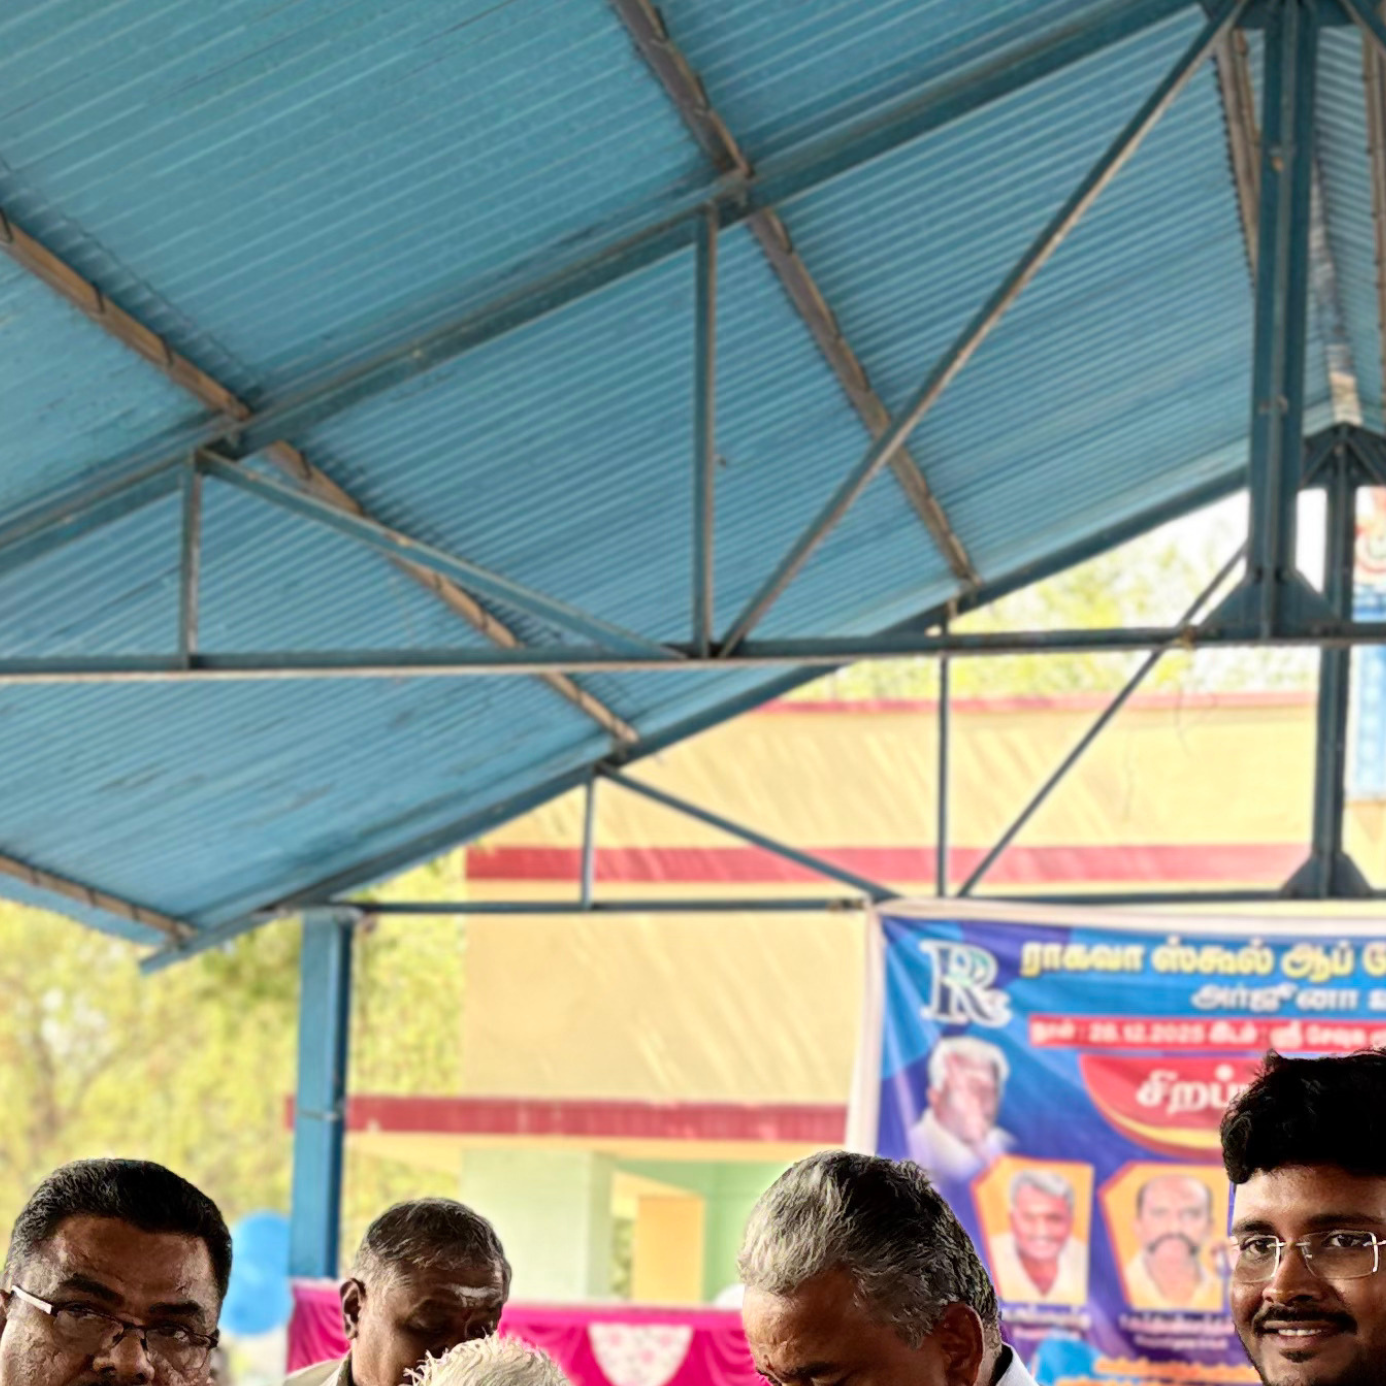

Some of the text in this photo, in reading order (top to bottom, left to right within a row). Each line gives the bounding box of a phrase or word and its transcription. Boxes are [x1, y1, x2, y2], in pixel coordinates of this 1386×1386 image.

[1020, 941, 1145, 977] ராகவா
[1151, 935, 1274, 977] ஸ்கூல்
[1281, 939, 1354, 983] ஆப்
